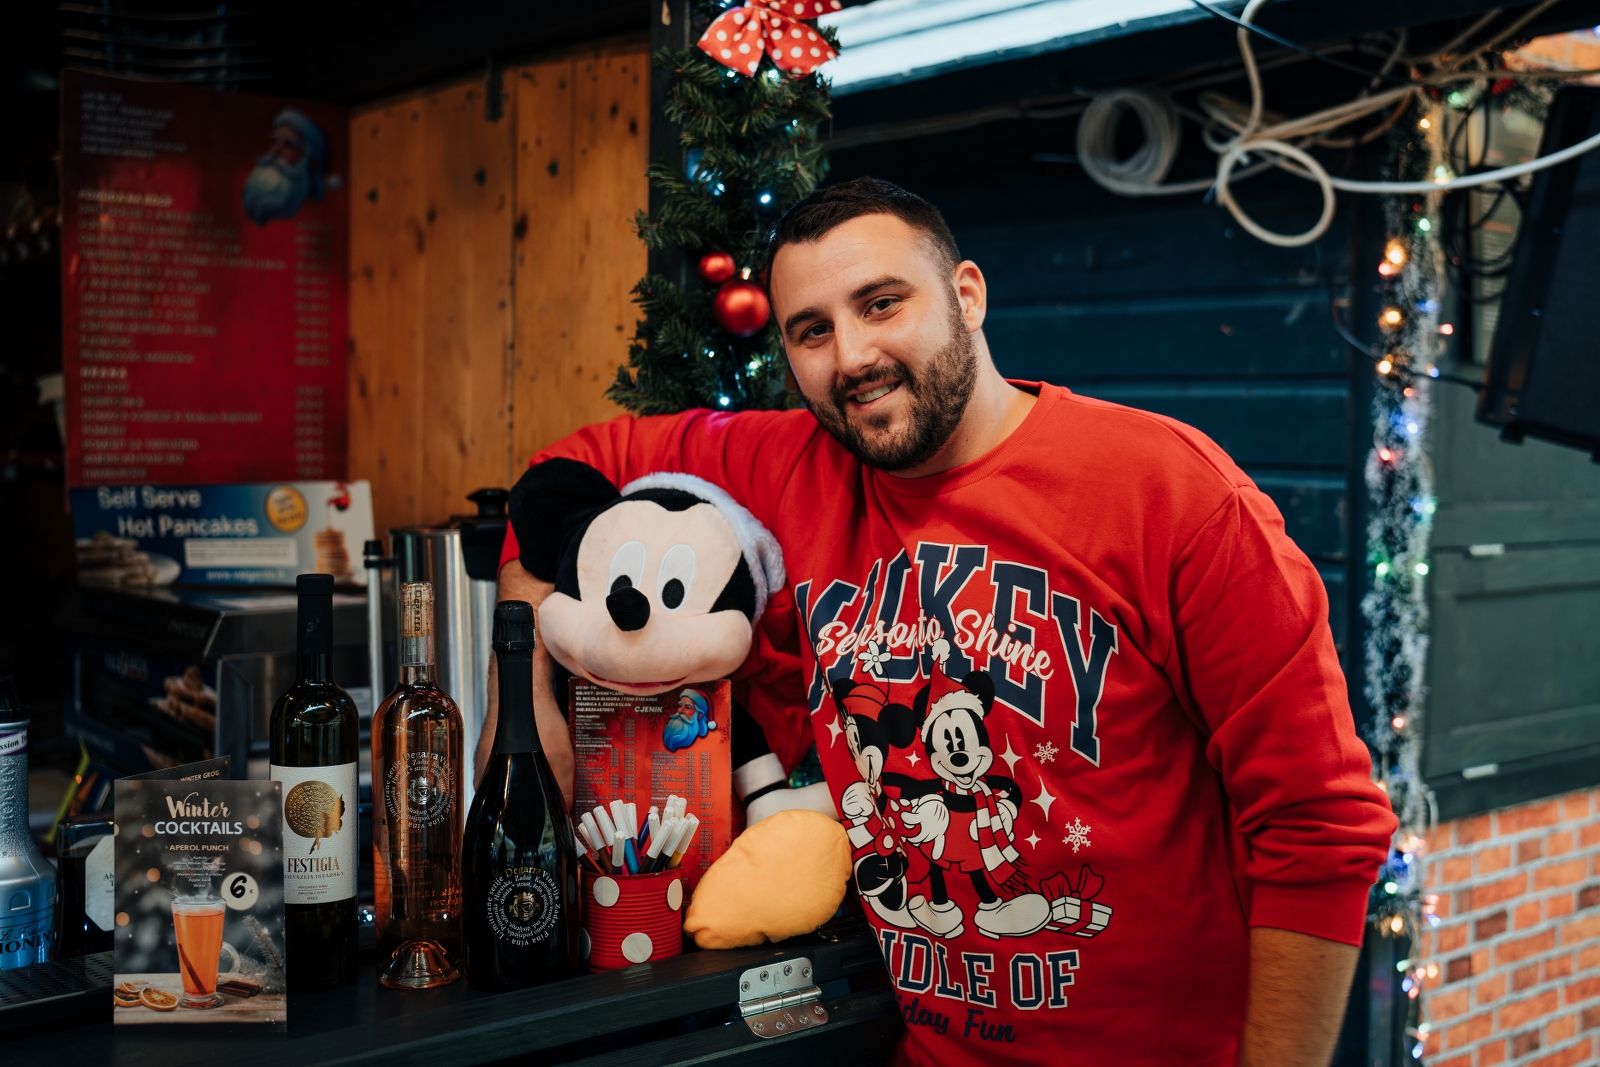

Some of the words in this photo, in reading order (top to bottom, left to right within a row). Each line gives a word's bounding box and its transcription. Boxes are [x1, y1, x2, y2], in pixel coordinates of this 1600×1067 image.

[98, 485, 137, 509] Self
[143, 485, 202, 509] Serve
[118, 515, 154, 537] Hot
[159, 514, 258, 538] Pancakes
[414, 590, 422, 632] Degarra
[954, 608, 1054, 680] Shine
[0, 740, 19, 752] ssion
[402, 751, 439, 761] Degarra
[202, 770, 220, 779] GROG
[165, 791, 231, 819] Winter
[154, 821, 243, 835] COCKTAILS
[407, 822, 426, 830] vina
[427, 814, 445, 828] Fina
[288, 856, 340, 873] FESTIGIA
[504, 866, 541, 878] Degarra
[230, 875, 247, 898] 6
[489, 876, 504, 896] serije
[542, 870, 560, 900] Vinarija
[486, 896, 505, 940] Limitirane
[0, 931, 51, 955] ONIN
[512, 939, 529, 948] vina
[532, 930, 550, 944] Fina
[1009, 948, 1080, 1011] OF
[897, 995, 950, 1036] day
[962, 1008, 1018, 1042] Fun
